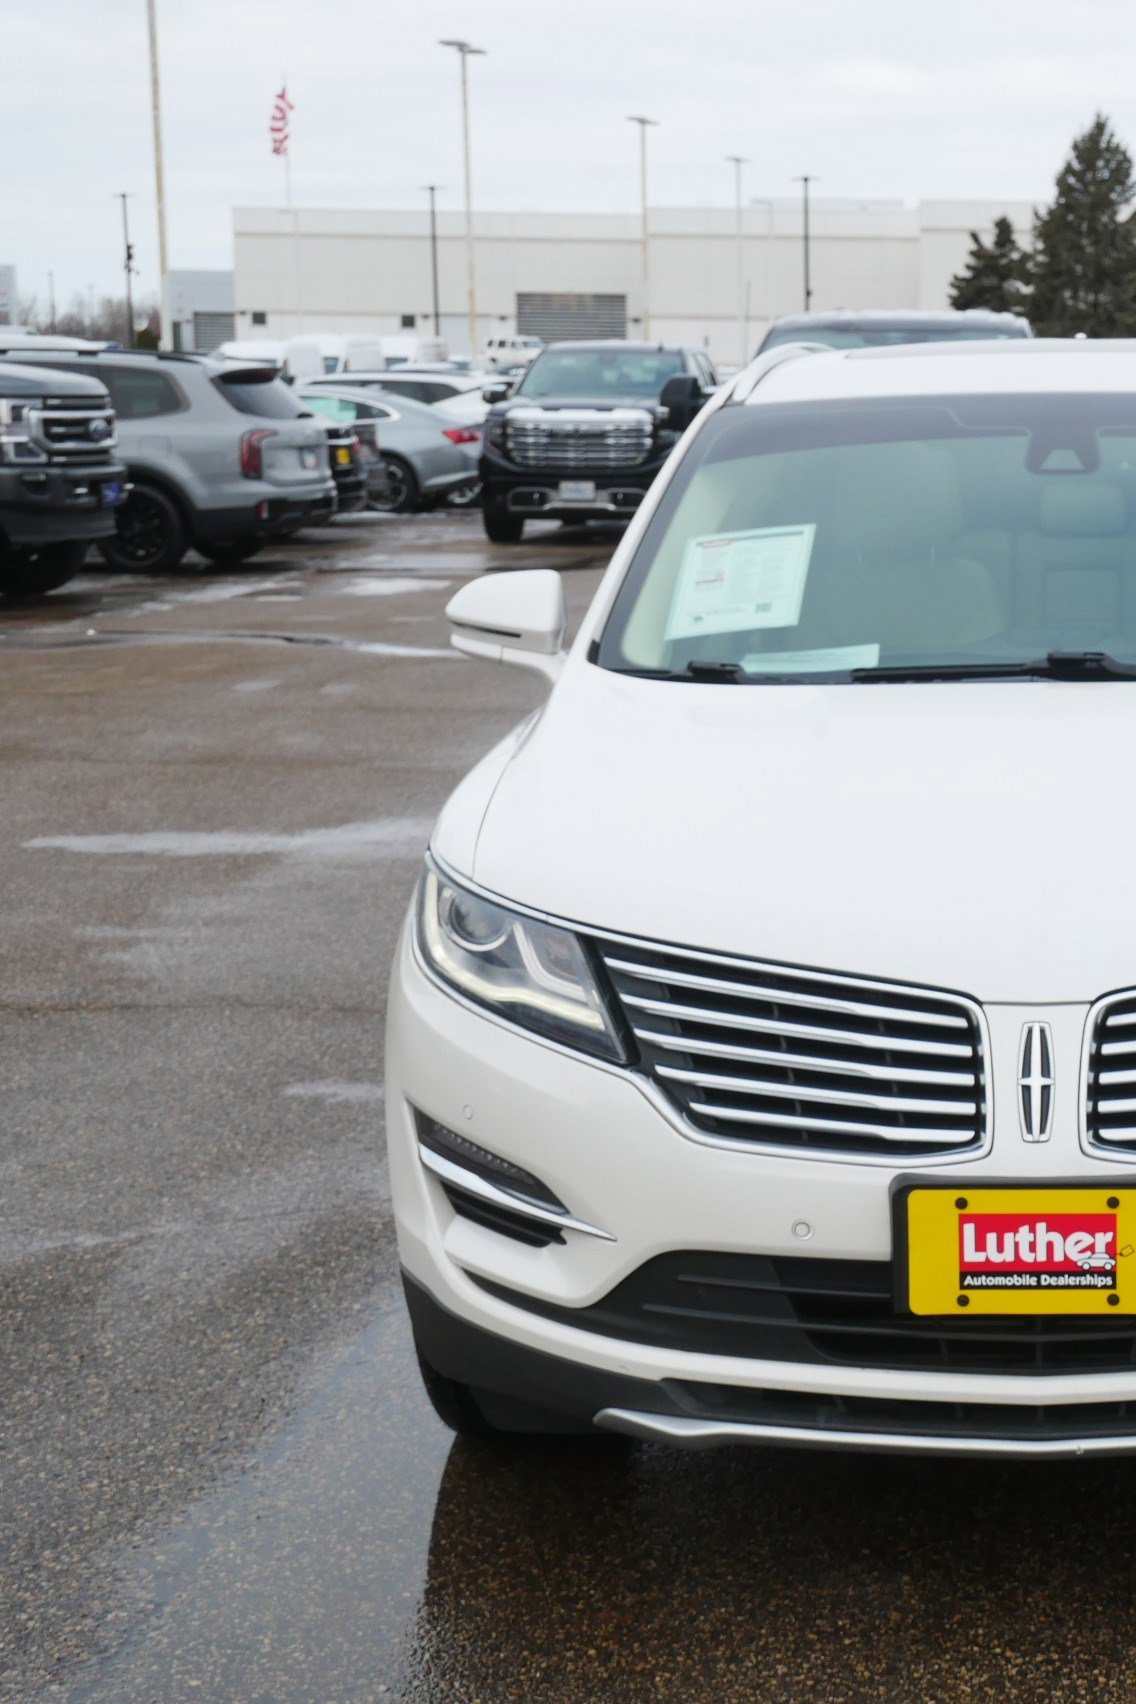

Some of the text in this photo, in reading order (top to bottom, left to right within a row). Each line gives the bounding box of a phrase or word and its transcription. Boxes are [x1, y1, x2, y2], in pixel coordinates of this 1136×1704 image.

[963, 1222, 1114, 1263] Luther
[963, 1274, 1113, 1288] Automobile Dealerships
